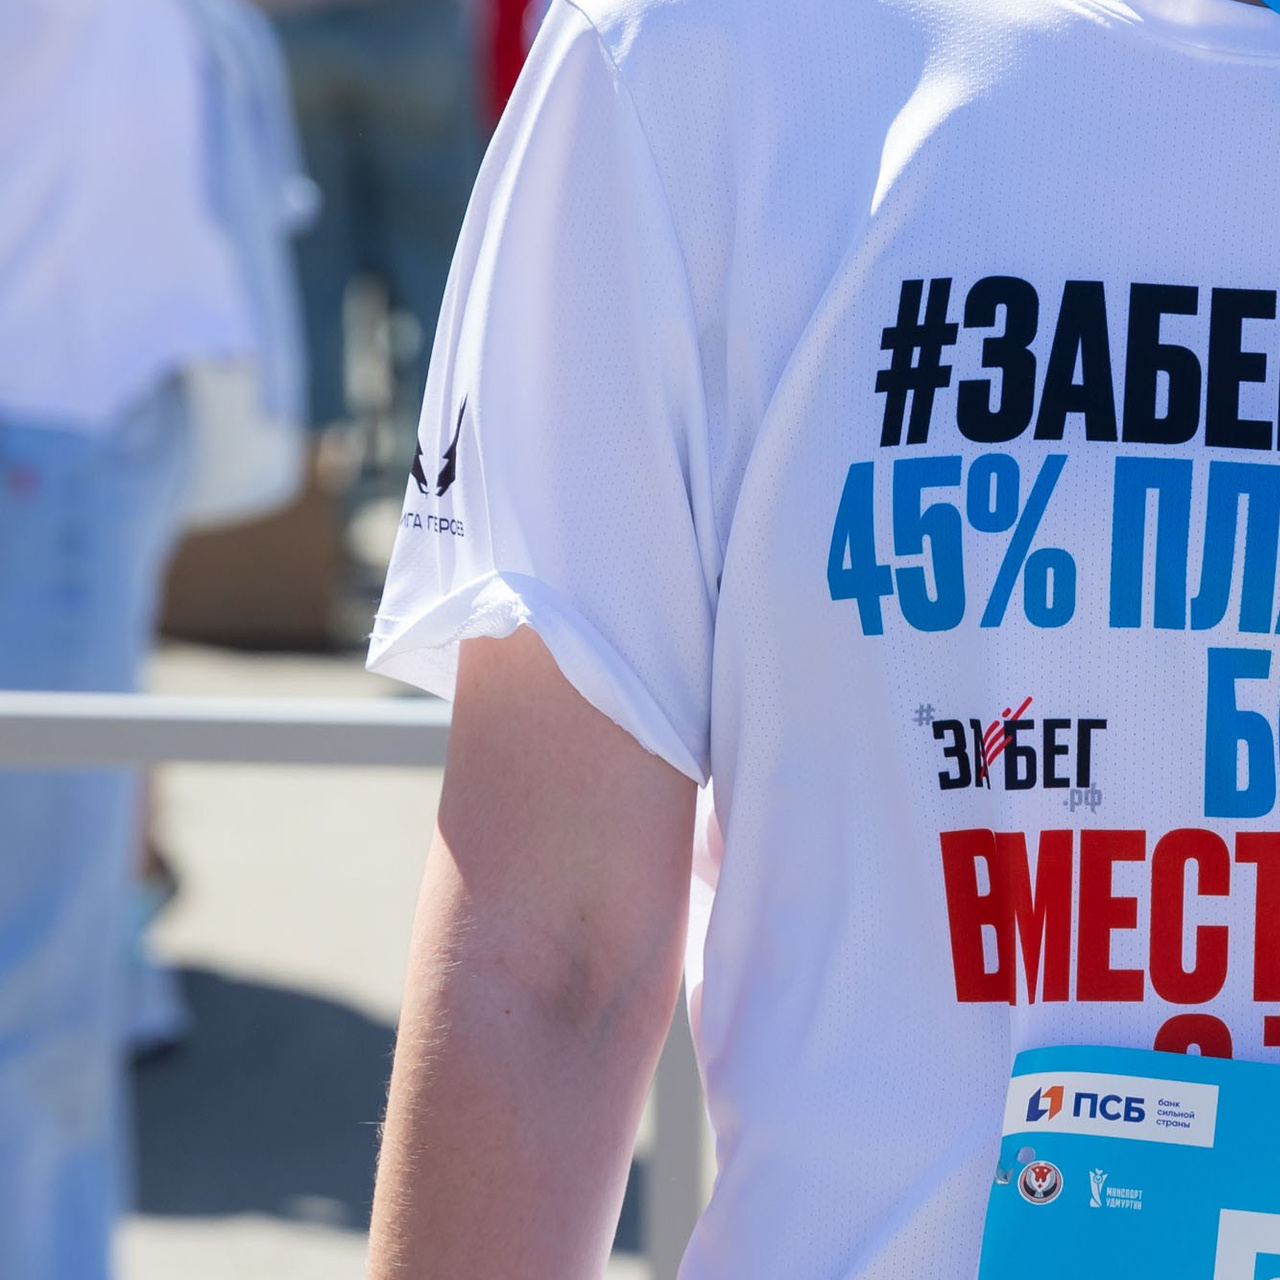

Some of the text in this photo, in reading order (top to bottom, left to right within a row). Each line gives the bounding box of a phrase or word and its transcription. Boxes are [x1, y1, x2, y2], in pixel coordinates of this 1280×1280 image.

[827, 453, 1077, 636] 45%
[1073, 1092, 1146, 1123] ПСБ
[1158, 1099, 1181, 1108] банк
[1157, 1108, 1195, 1119] сильной
[1156, 1119, 1191, 1128] страны
